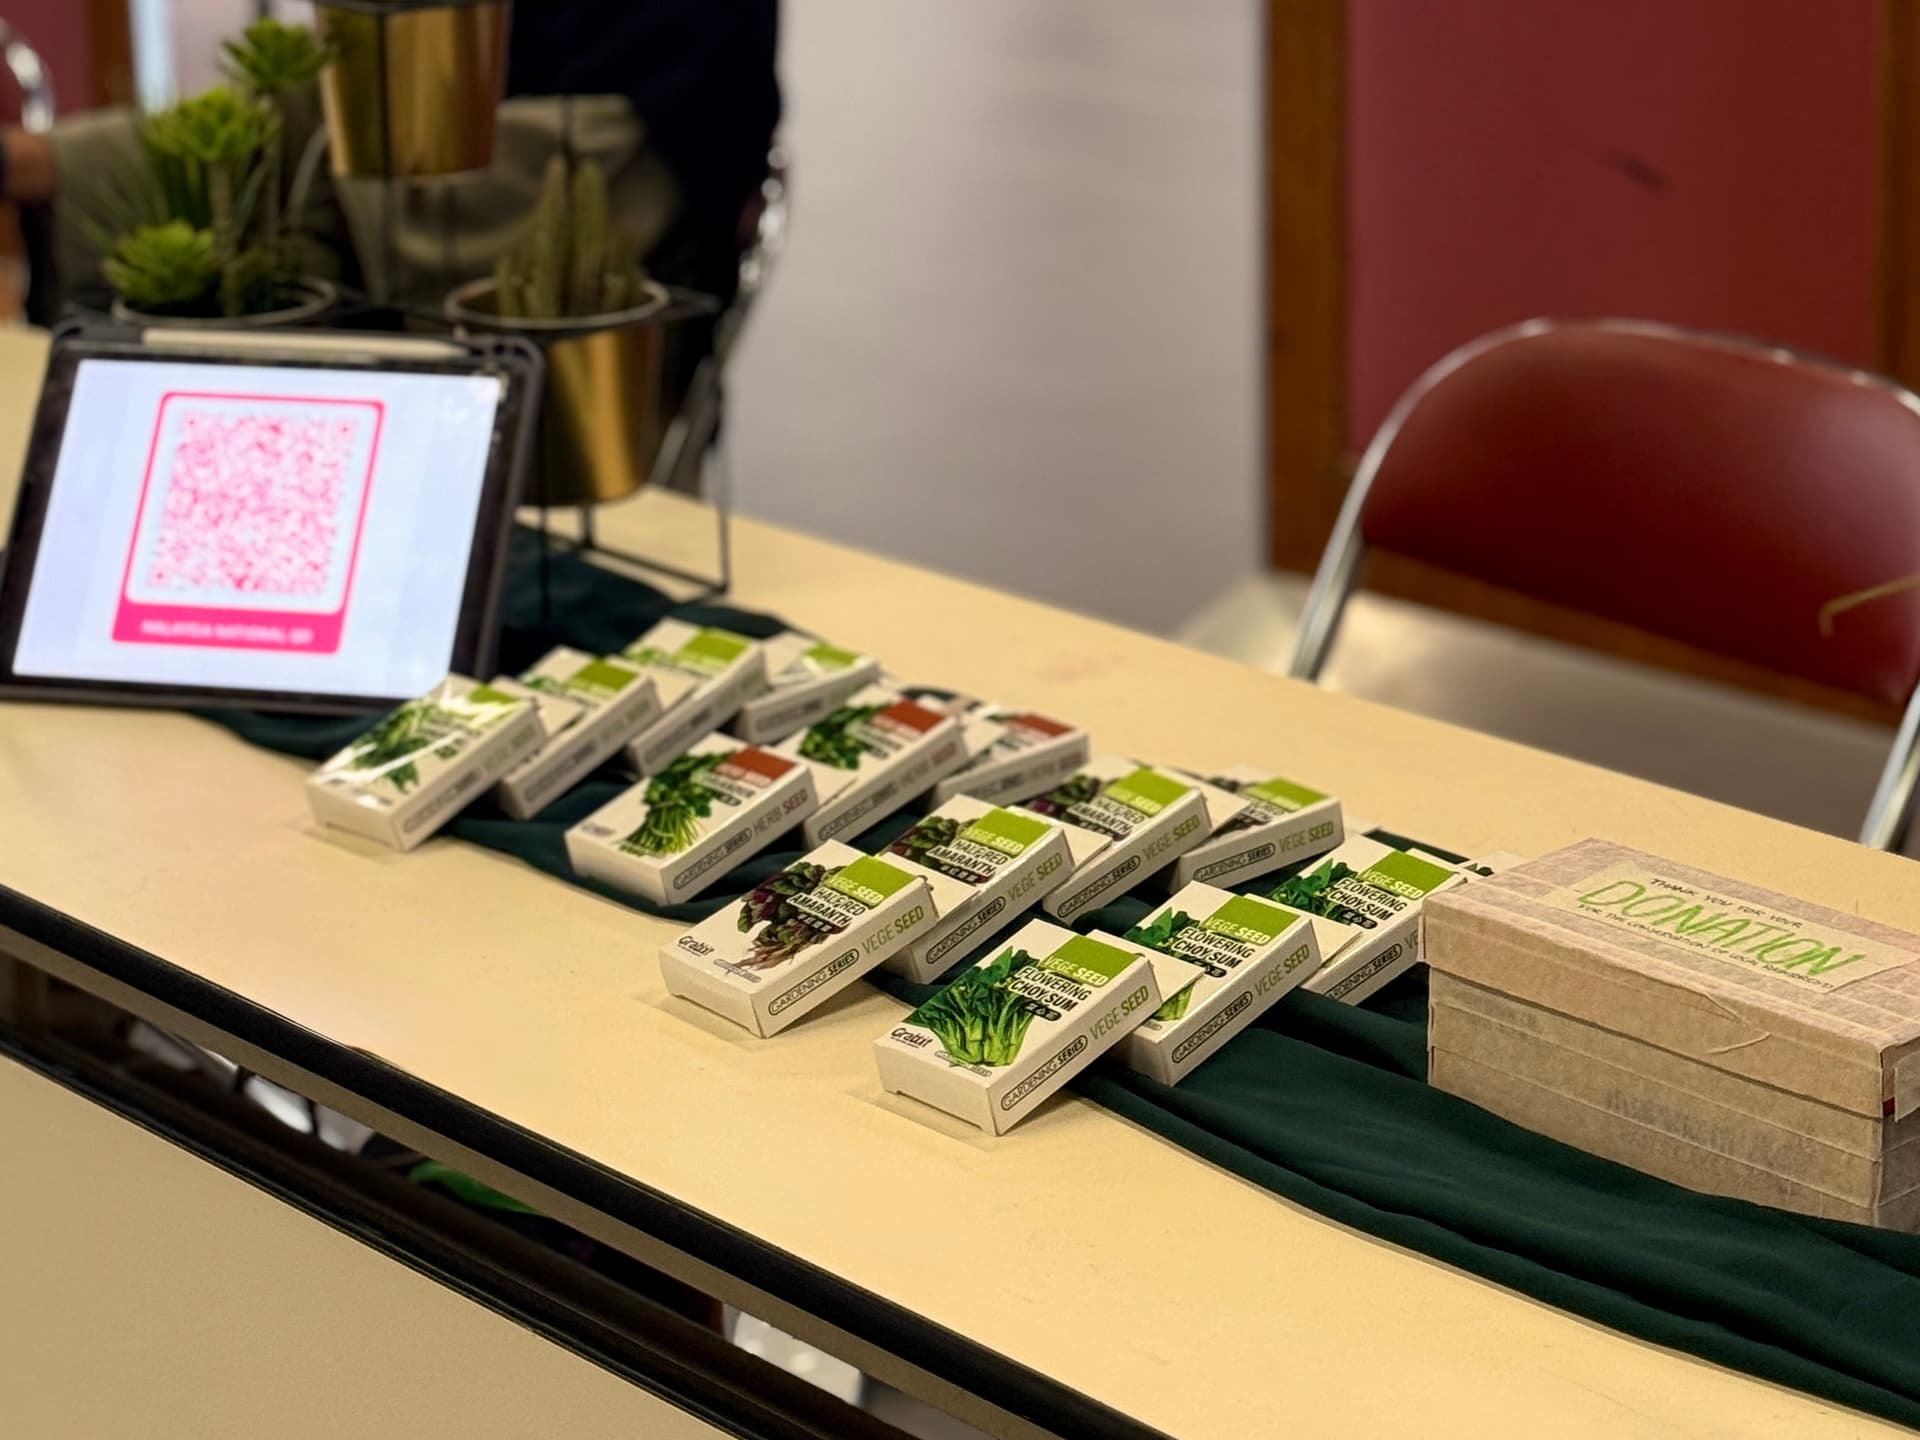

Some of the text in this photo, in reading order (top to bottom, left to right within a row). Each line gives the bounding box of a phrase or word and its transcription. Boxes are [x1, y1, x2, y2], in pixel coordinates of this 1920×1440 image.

[752, 807, 782, 834] HERB
[782, 789, 808, 815] SEED
[991, 837, 1025, 853] SEED
[1143, 832, 1174, 860] VEGE
[1173, 814, 1201, 841] SEED
[1279, 832, 1307, 853] VEGE
[1307, 821, 1334, 843] SEED
[930, 846, 997, 876] AMARANTH
[828, 874, 885, 903] VEGE SEED
[1336, 878, 1408, 912] FLOWERING
[1360, 868, 1425, 899] VEGE SEED
[790, 894, 853, 926] AMARANTH
[928, 921, 978, 962] GARDENING
[978, 901, 1002, 922] SERIES
[1007, 872, 1037, 901] VEGE
[1036, 852, 1063, 880] SEED
[1330, 890, 1367, 908] CHOY
[1361, 903, 1395, 921] SUM
[1704, 895, 1734, 907] YOU
[1180, 927, 1256, 959] FLOWERING
[1204, 917, 1272, 945] VEGE SEED
[1577, 880, 1867, 976] DONATION
[771, 905, 925, 1014] GARDENING SERIES VEGE SEED
[1173, 939, 1244, 969] CHOY SUM
[1373, 947, 1399, 971] SERIES
[1019, 967, 1092, 1001] FLOWERING
[1043, 955, 1109, 987] VEGE SEED
[1010, 980, 1049, 1000] CHOY
[1044, 993, 1079, 1012] SUM
[1174, 1015, 1225, 1061] GARDENING
[1224, 994, 1250, 1020] SERIES
[1254, 966, 1284, 996] VEGE
[1283, 944, 1310, 975] SEED
[1003, 1063, 1058, 1108] GARDENING
[1057, 1038, 1084, 1065] SERIES
[1089, 1008, 1121, 1041] VEGE
[1121, 985, 1150, 1017] SEED
